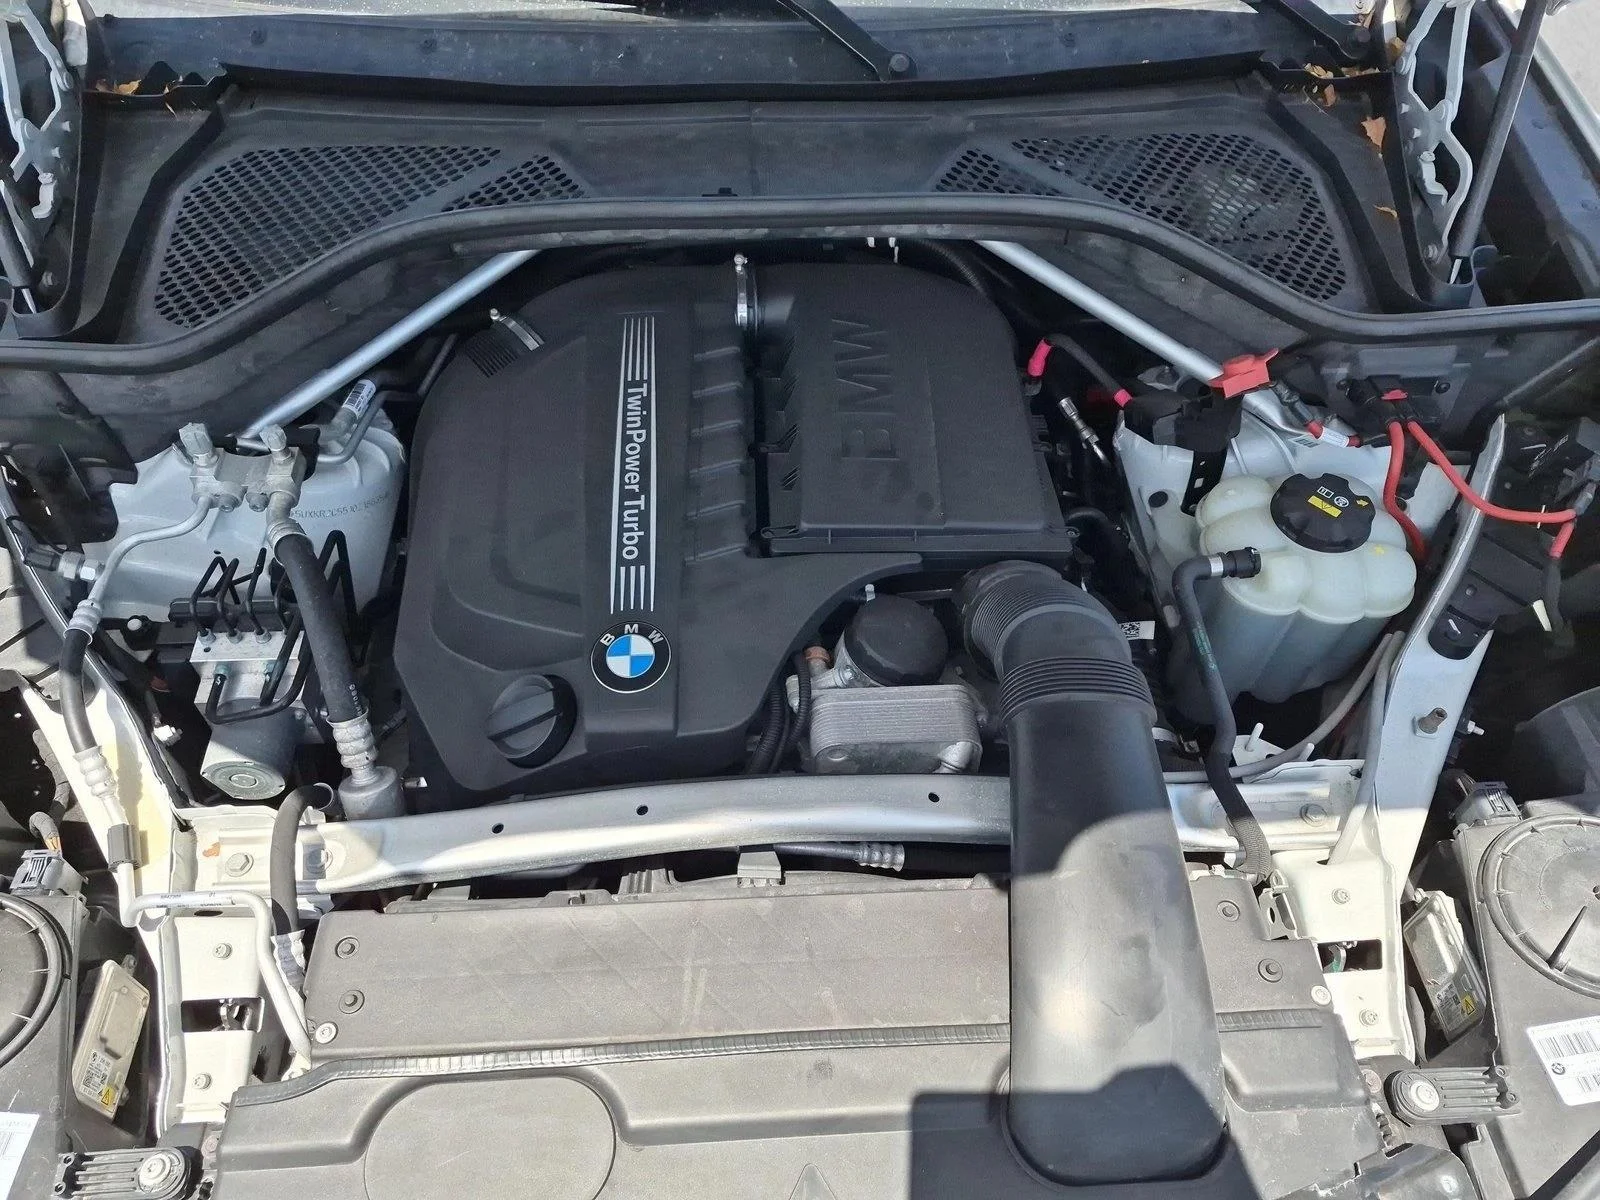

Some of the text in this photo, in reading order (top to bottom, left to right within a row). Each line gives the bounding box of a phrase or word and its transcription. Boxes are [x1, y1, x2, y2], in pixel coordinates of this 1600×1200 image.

[831, 317, 901, 461] BMW
[622, 383, 648, 560] TwinPower Turbo
[600, 623, 664, 646] BMW
